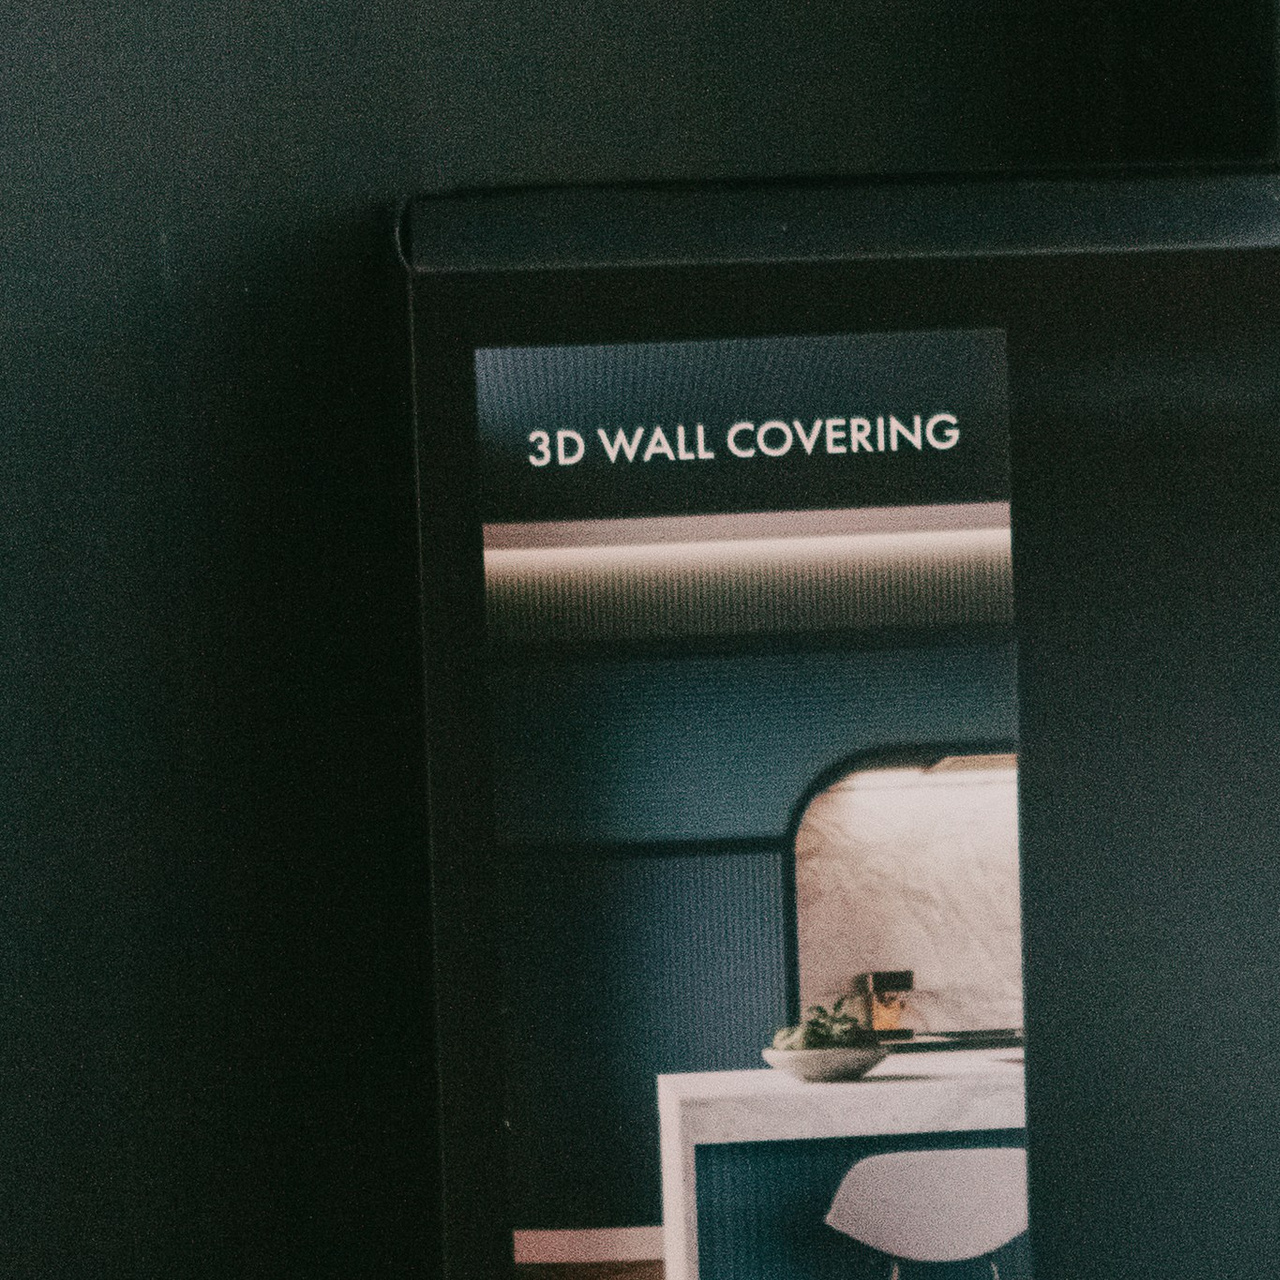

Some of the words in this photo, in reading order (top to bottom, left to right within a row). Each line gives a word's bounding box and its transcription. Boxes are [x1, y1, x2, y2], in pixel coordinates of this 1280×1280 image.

[528, 429, 585, 467] 3D
[598, 424, 714, 463] WALL
[727, 413, 961, 458] COVERING
